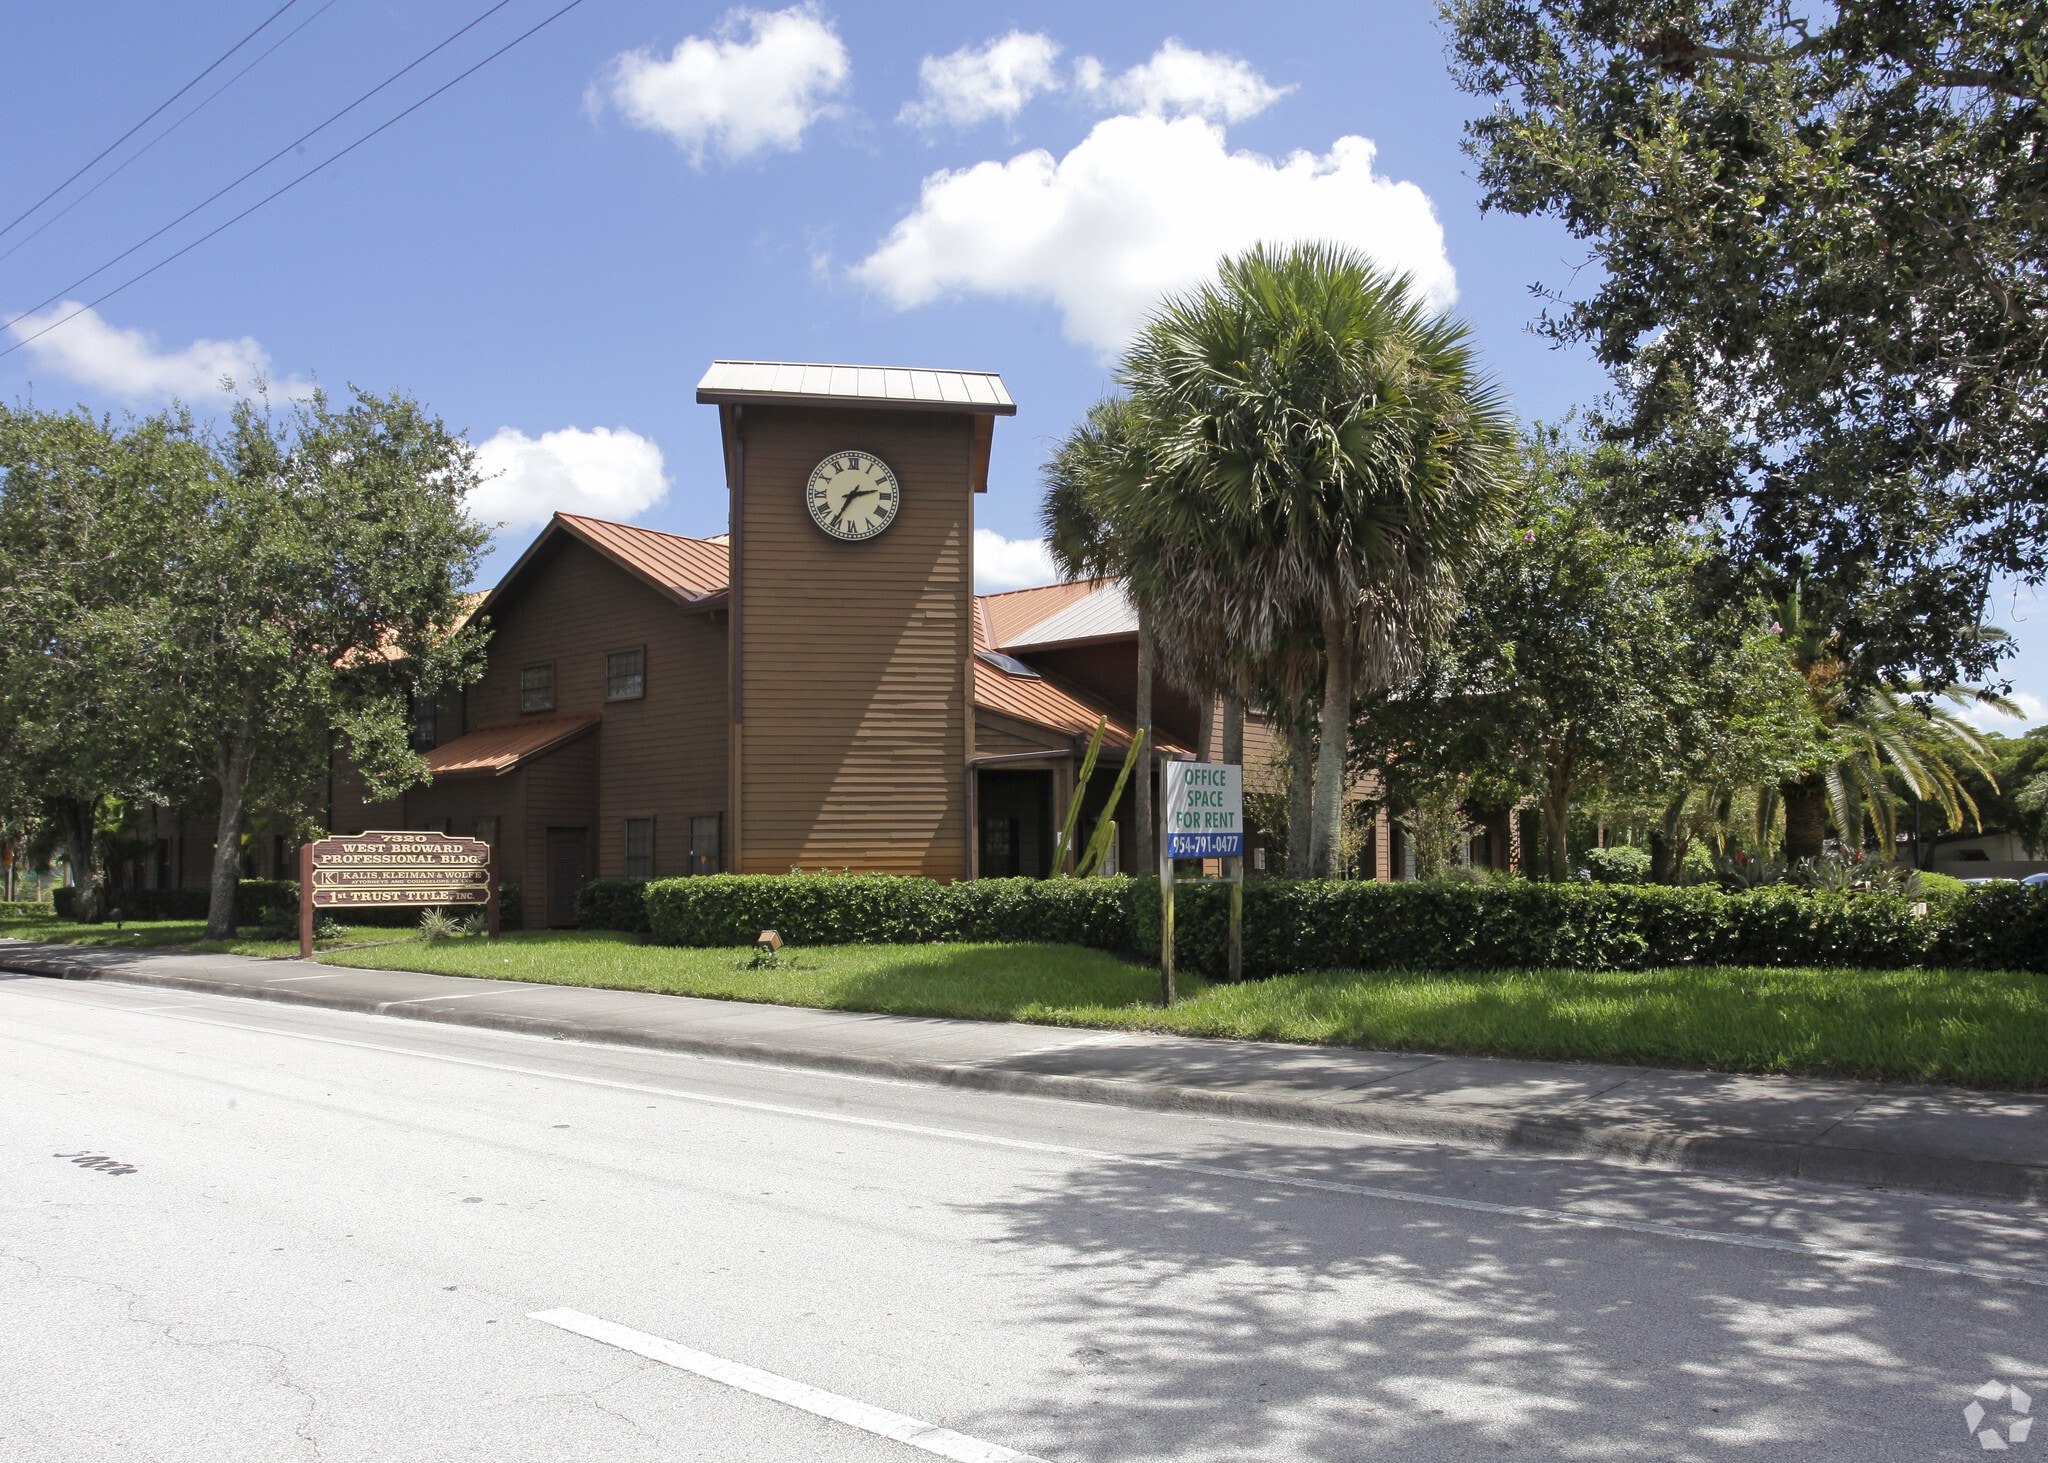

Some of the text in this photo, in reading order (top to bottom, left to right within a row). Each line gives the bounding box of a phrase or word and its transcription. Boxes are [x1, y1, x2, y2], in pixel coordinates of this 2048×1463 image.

[1184, 768, 1226, 786] OFFICE
[1187, 790, 1223, 807] SPACE
[1176, 811, 1235, 828] FOR RENT
[381, 834, 427, 843] 7320
[1173, 835, 1239, 853] 954-791-0477
[342, 843, 463, 853] WEST BROWARD
[321, 854, 481, 864] PROFESSIONAL BLDG.
[445, 871, 482, 879] WOLFE
[329, 891, 347, 903] 1st
[351, 891, 400, 901] TRUST
[456, 892, 475, 900] INC.
